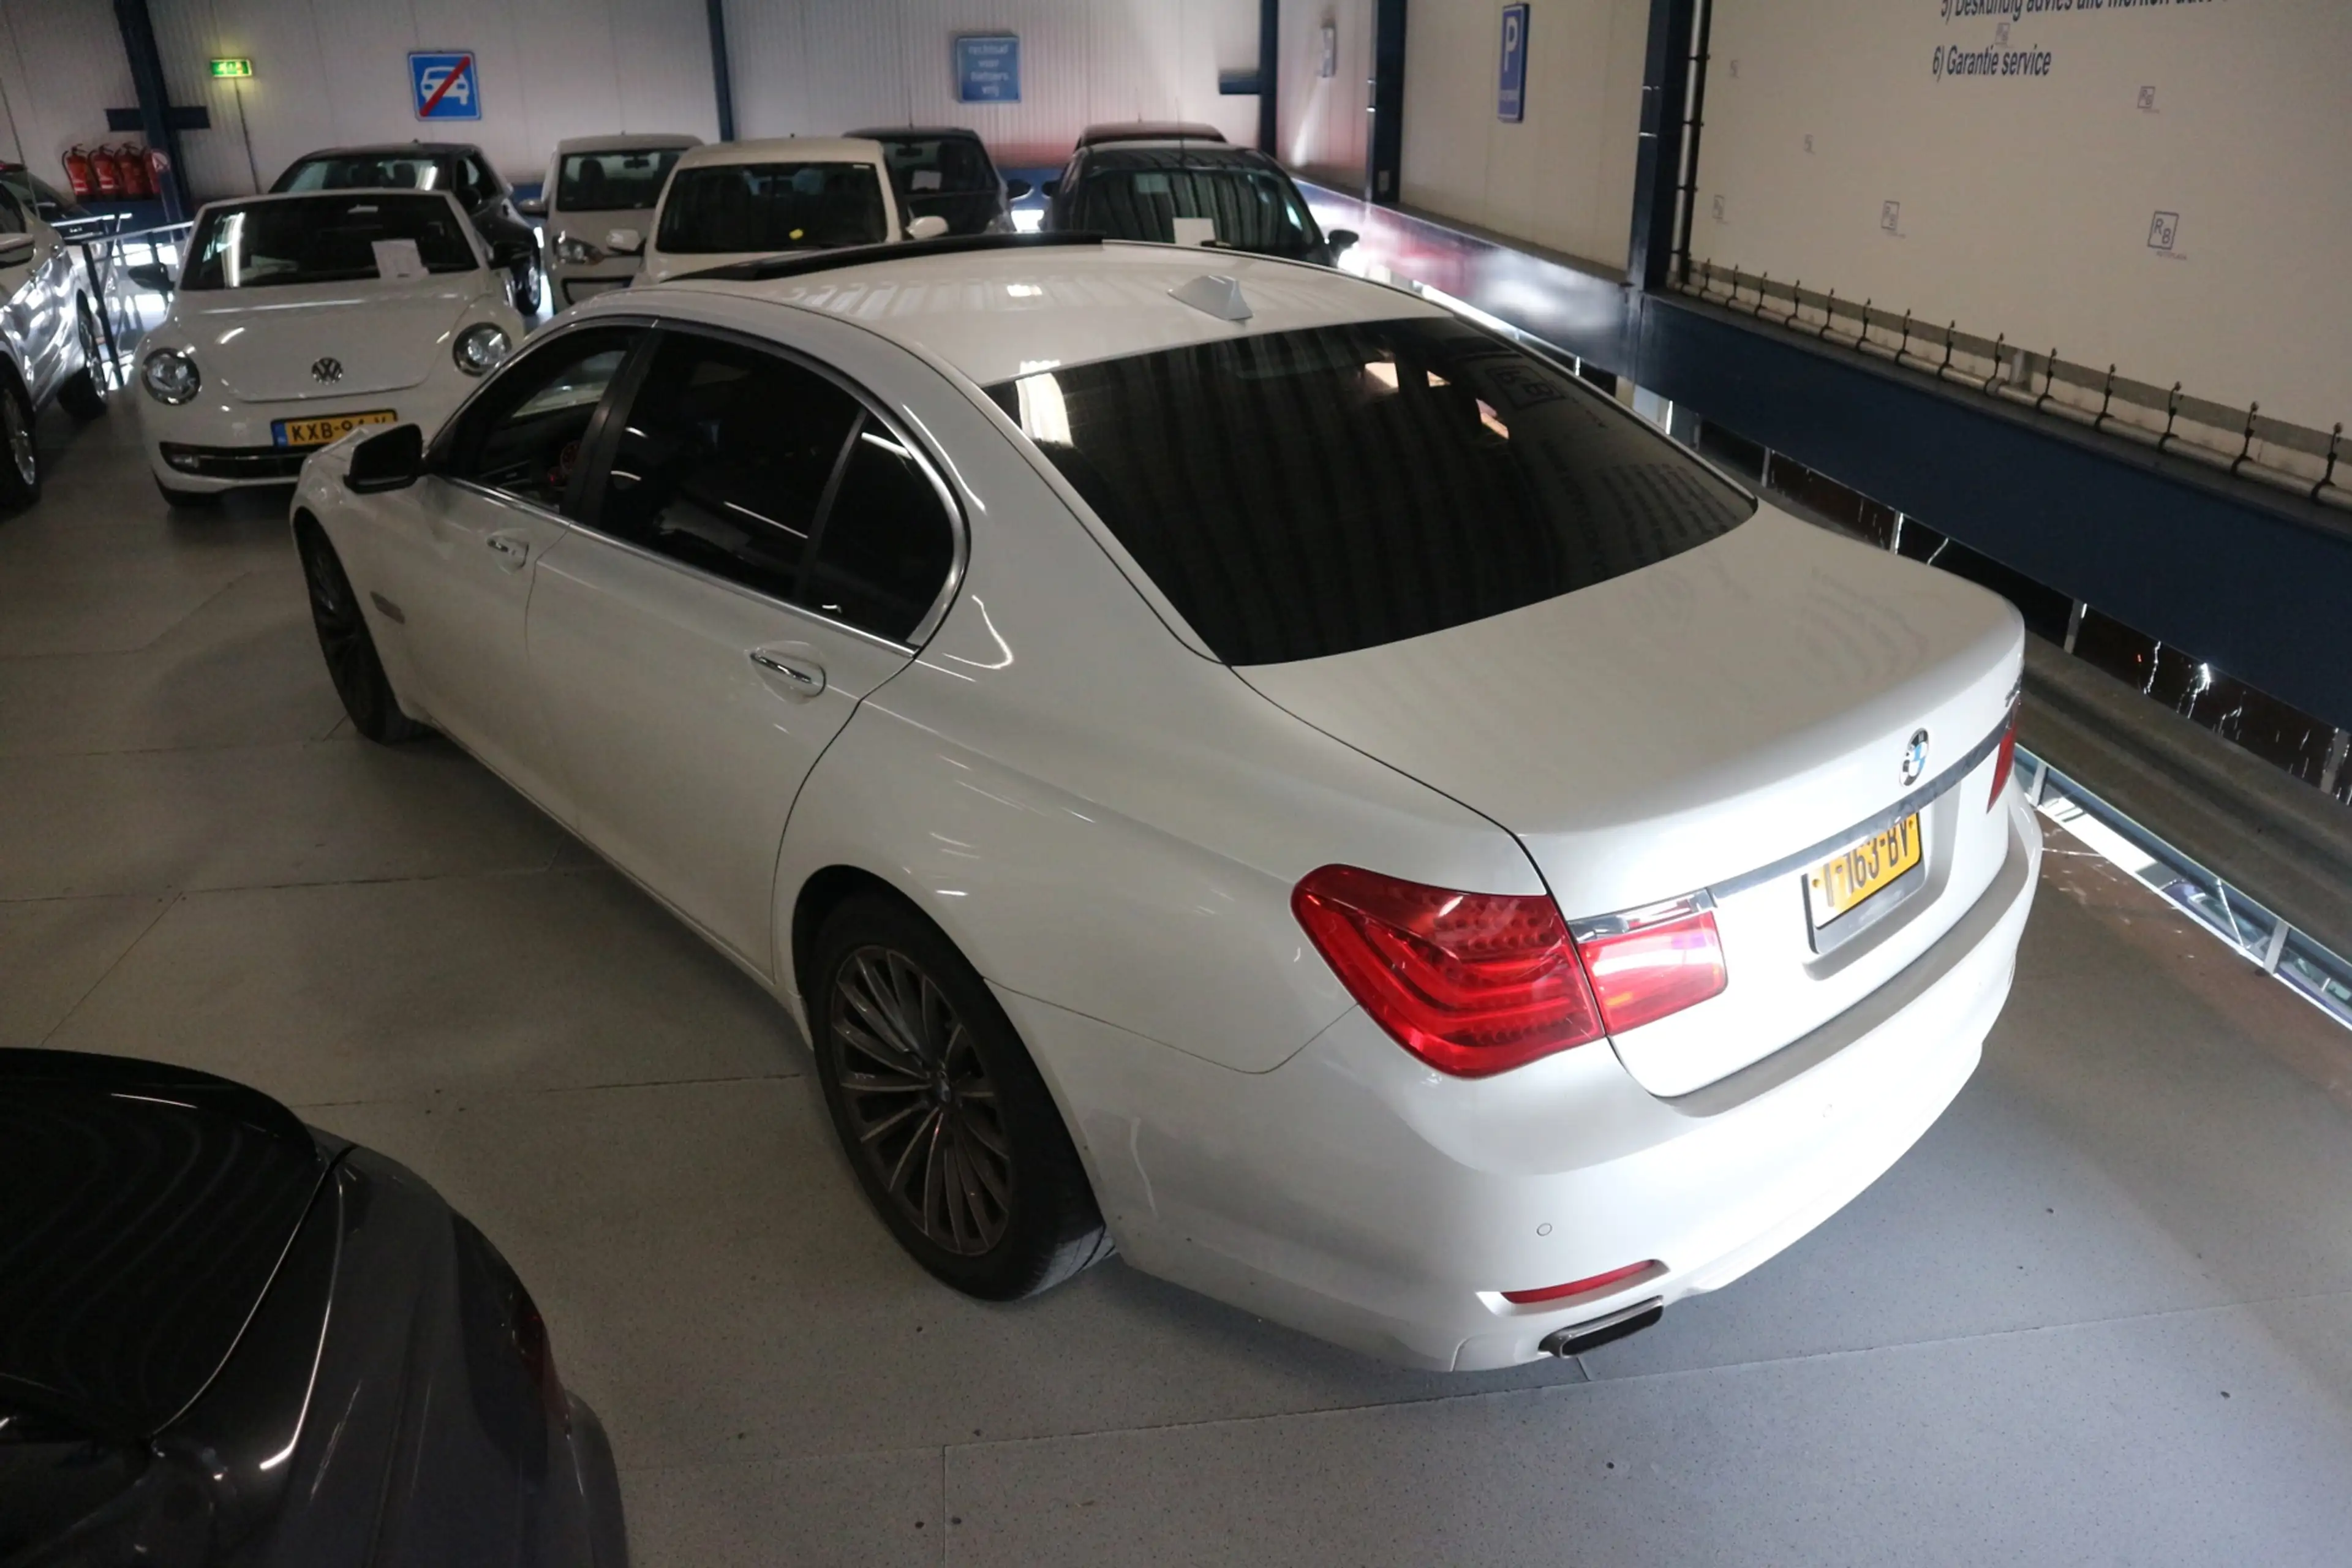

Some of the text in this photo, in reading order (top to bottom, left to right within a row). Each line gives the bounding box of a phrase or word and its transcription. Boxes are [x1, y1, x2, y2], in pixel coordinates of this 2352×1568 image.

[1504, 16, 1518, 72] P
[1932, 44, 2052, 83] 6) Garantie service
